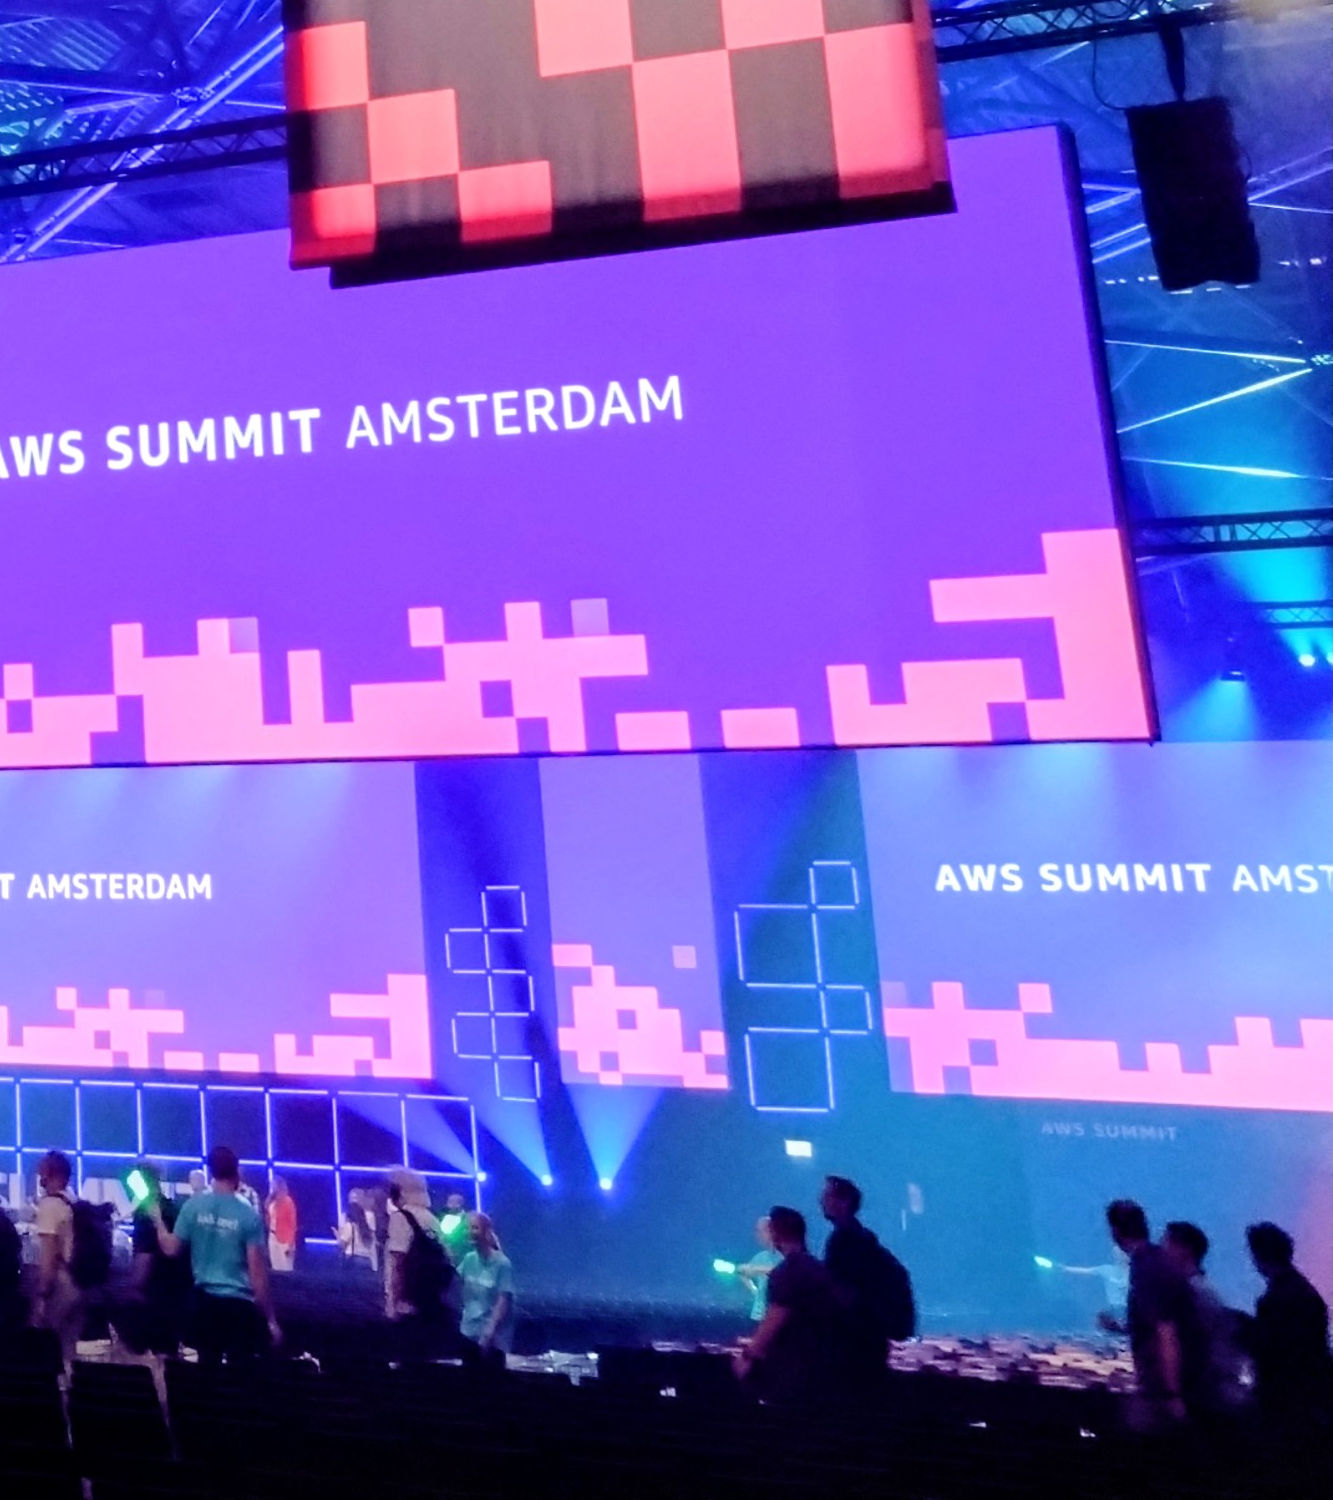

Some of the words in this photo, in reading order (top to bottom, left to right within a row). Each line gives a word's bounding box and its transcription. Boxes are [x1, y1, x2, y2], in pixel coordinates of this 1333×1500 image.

[106, 408, 321, 471] SUMMIT
[346, 375, 683, 449] AMSTERDAM
[27, 873, 212, 900] AMSTERDAM
[935, 863, 1024, 892] AWS
[1039, 863, 1211, 892] SUMMIT
[1040, 1121, 1085, 1137] AWS
[1092, 1123, 1177, 1141] SUMMIT
